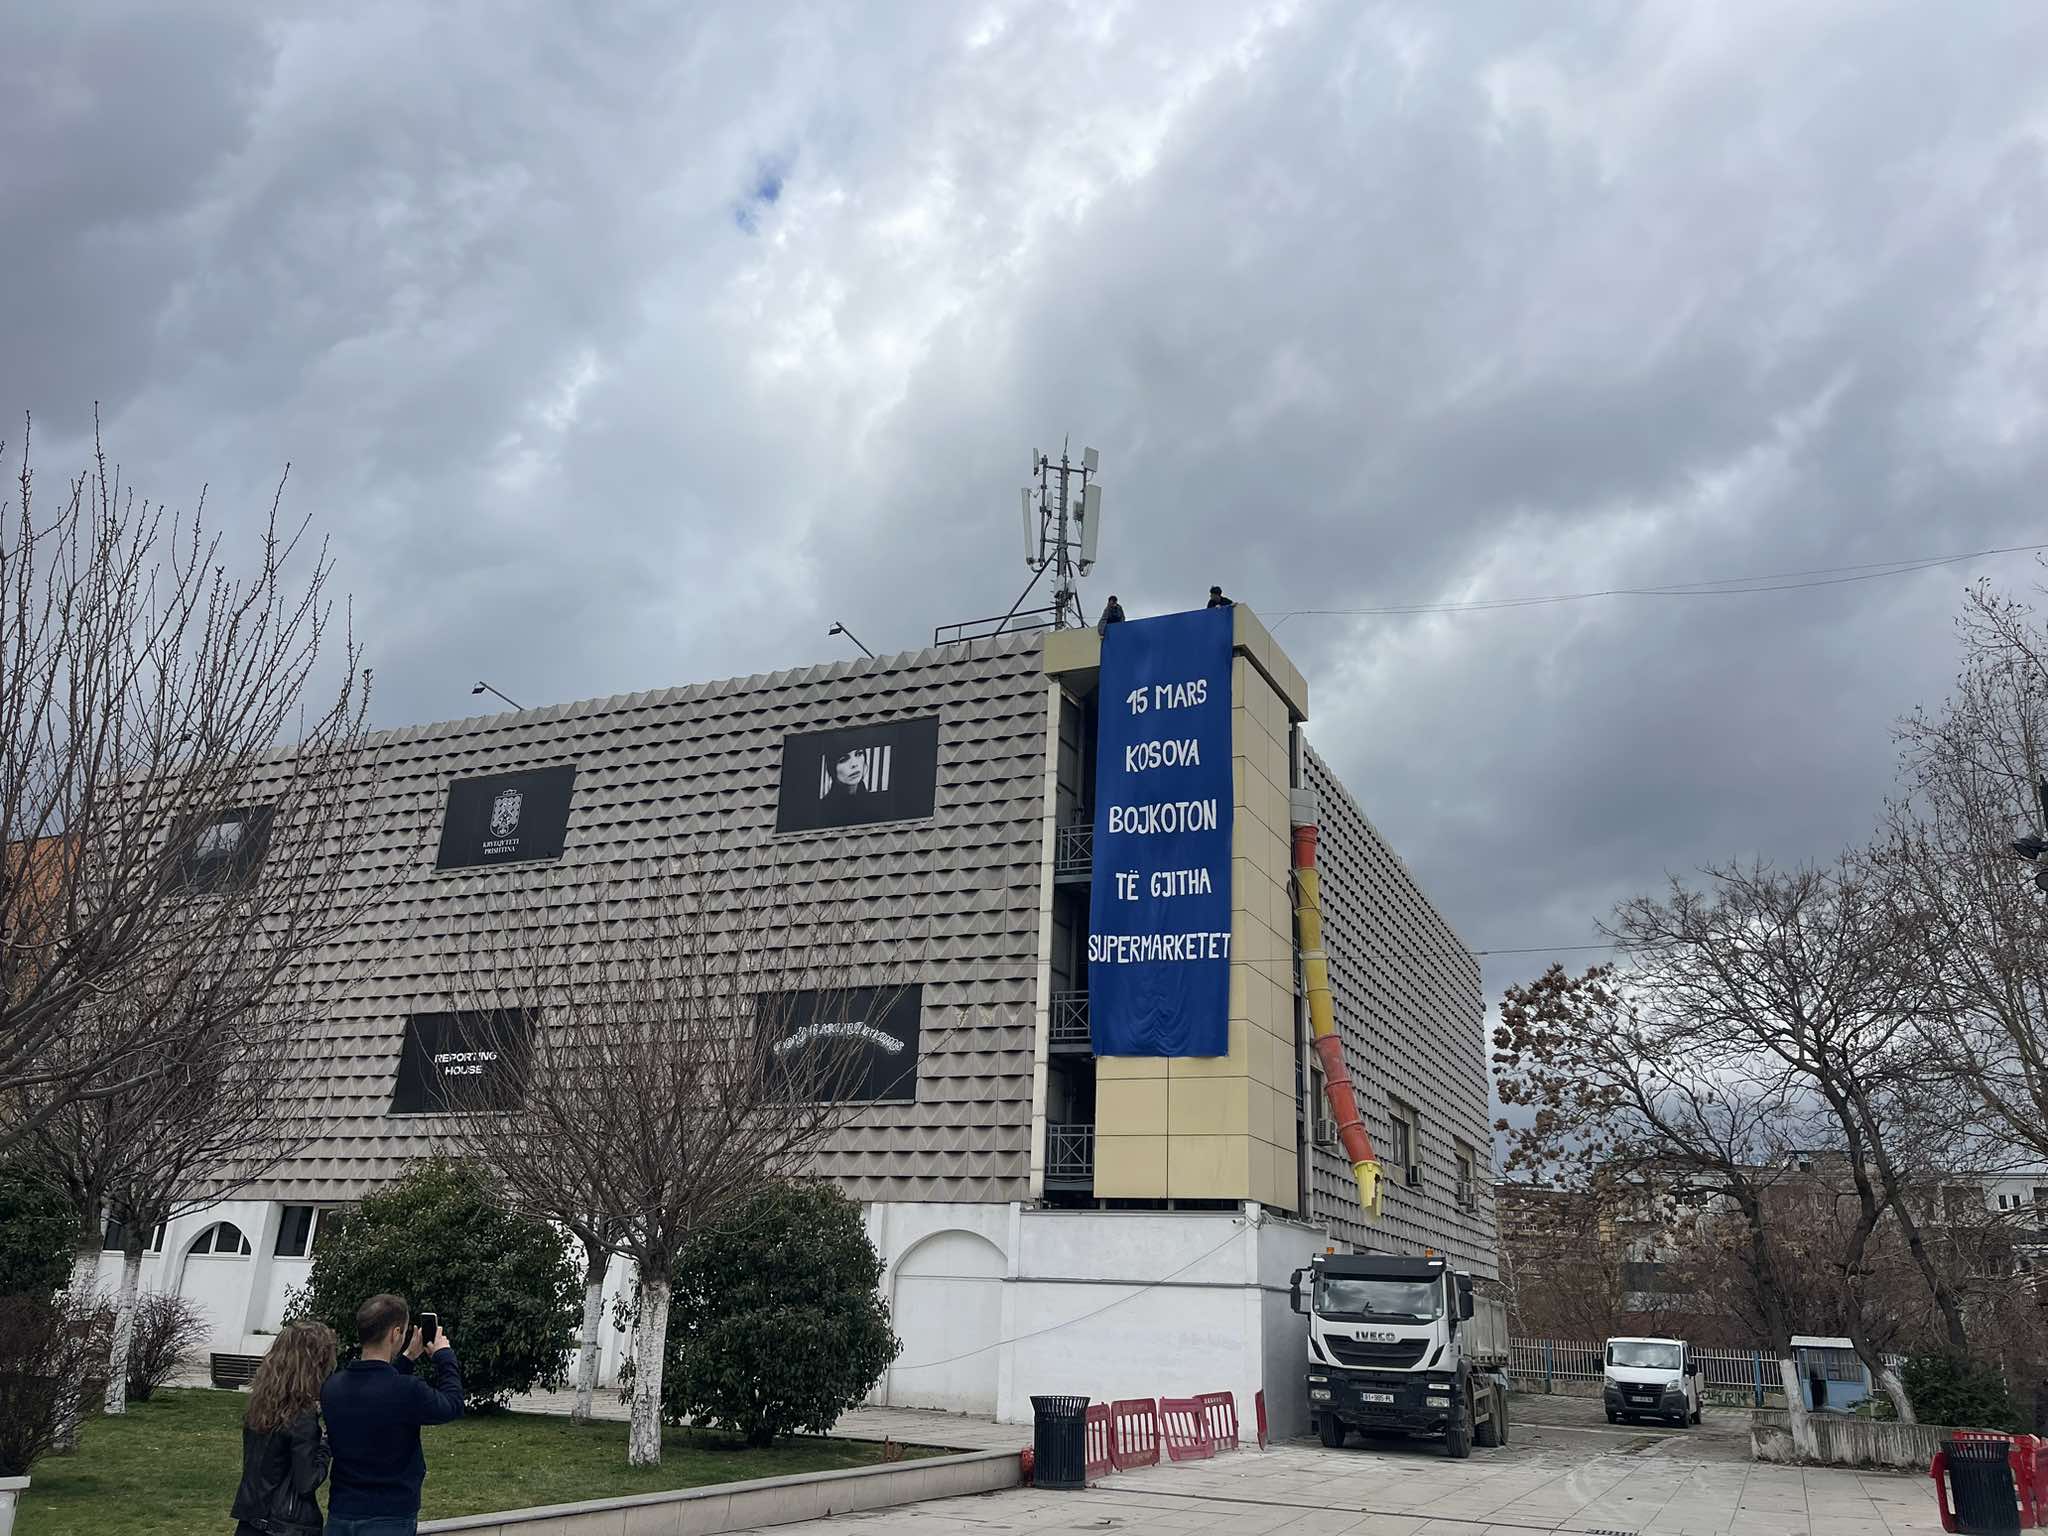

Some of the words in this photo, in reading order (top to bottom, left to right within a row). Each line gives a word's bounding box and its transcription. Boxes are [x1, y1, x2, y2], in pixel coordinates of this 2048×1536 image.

[1126, 686, 1149, 715] 15
[1155, 679, 1207, 710] MARS
[1125, 739, 1200, 773] KOSOVA
[1108, 798, 1217, 834] BOJKOTON
[1115, 869, 1140, 901] TË
[1150, 867, 1212, 898] GJITHA
[1087, 932, 1232, 963] SUPERMARKETET
[444, 1065, 482, 1076] HOUSE
[1355, 1331, 1396, 1342] IVECO
